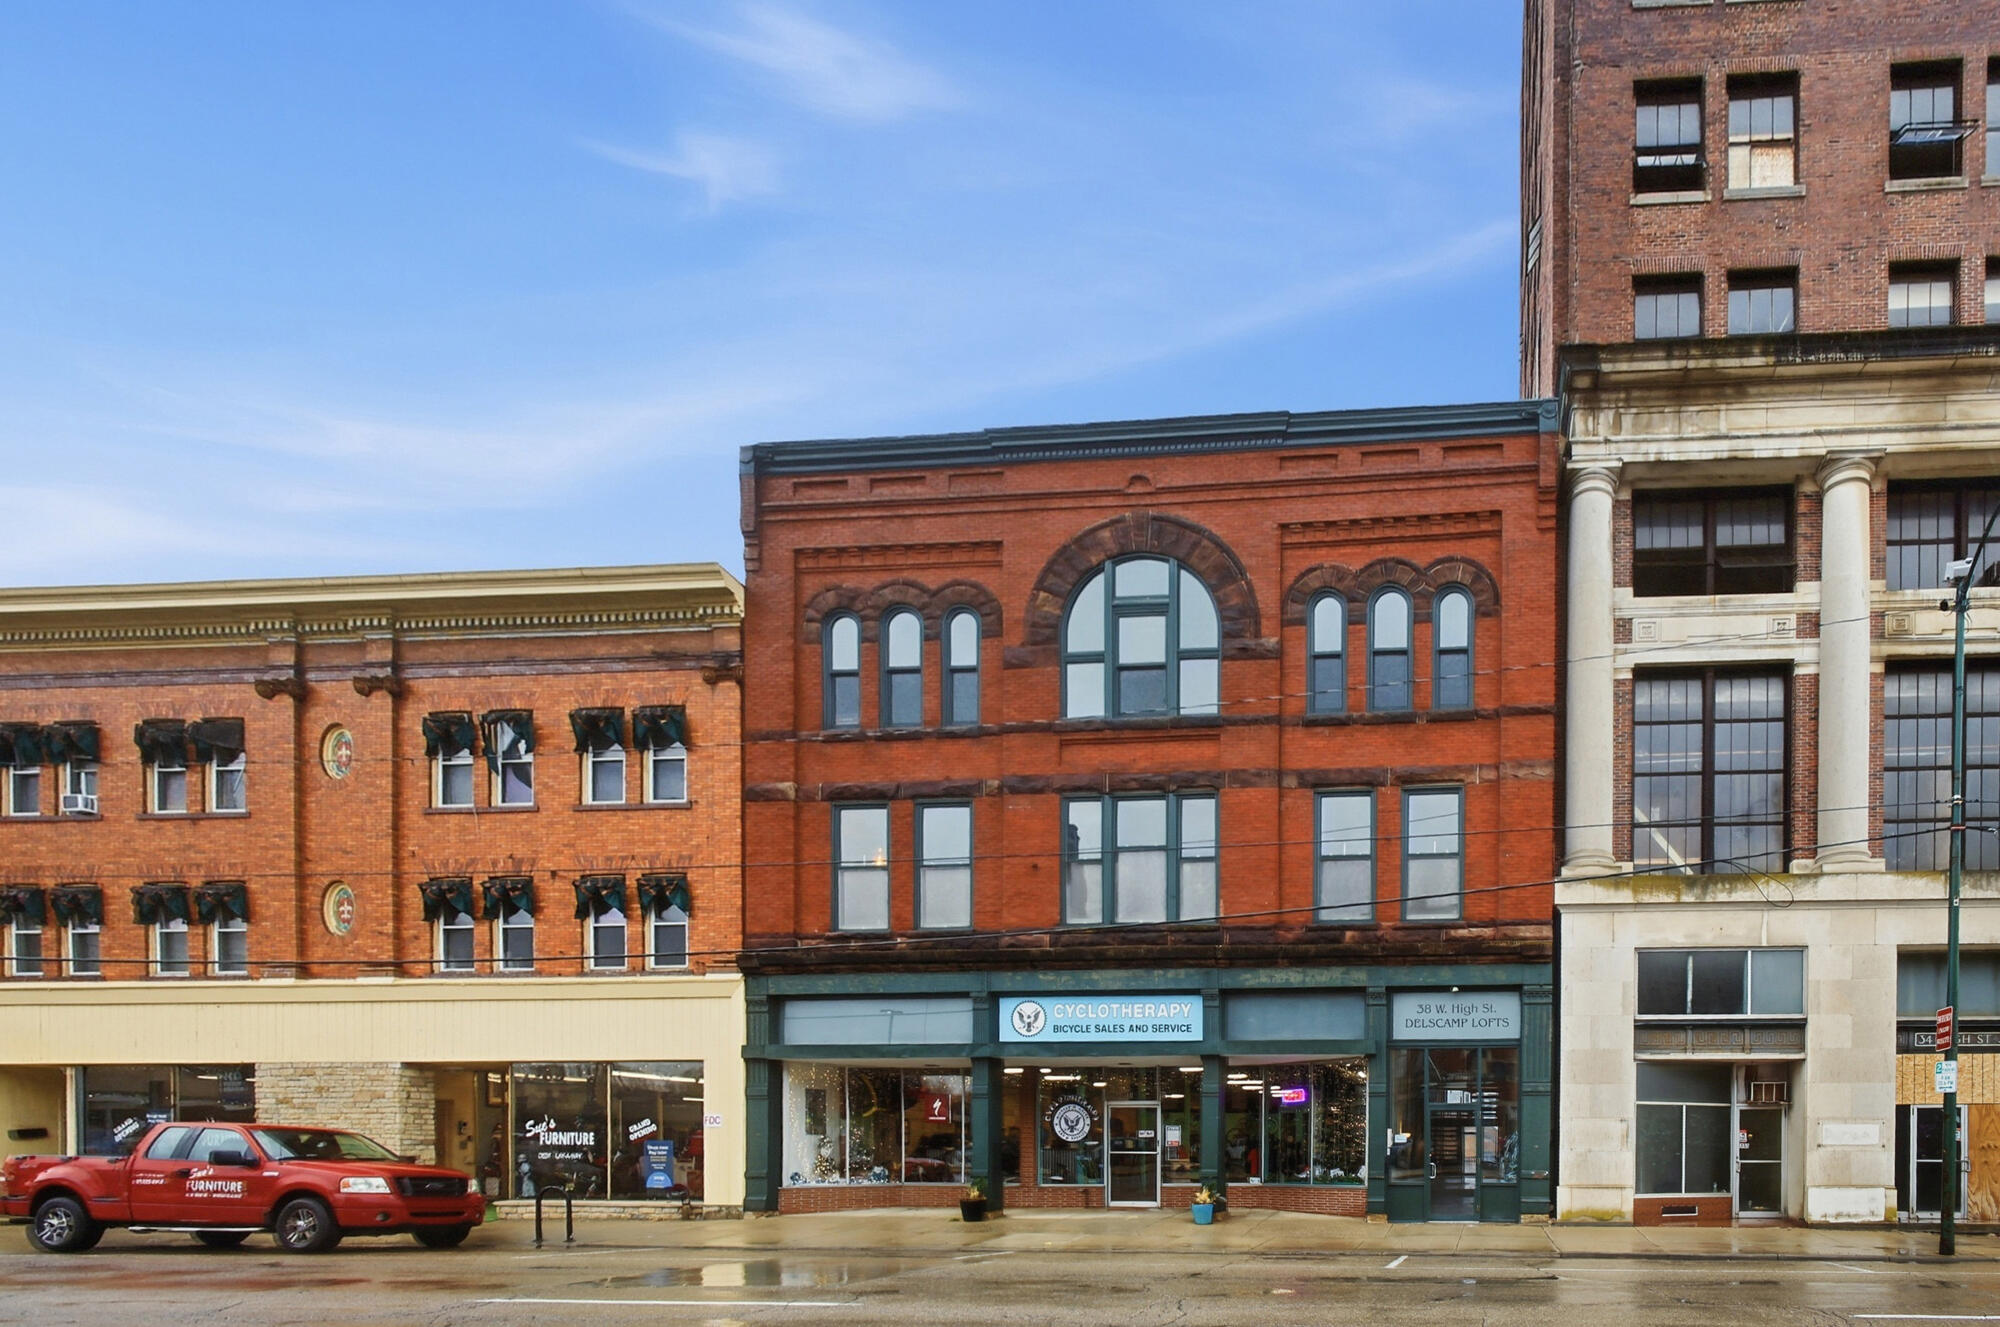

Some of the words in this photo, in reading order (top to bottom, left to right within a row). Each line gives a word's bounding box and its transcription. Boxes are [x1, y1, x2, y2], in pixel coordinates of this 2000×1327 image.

[1053, 1003, 1192, 1018] CYCLOTHERAPY
[1416, 1004, 1432, 1014] 38
[1435, 1003, 1447, 1014] W.
[1452, 1003, 1478, 1016] High
[1482, 1003, 1497, 1014] St.
[1053, 1024, 1091, 1033] BICYCLE
[1094, 1024, 1125, 1033] SALES
[1128, 1024, 1148, 1033] AND
[1151, 1023, 1192, 1033] SERVICE
[1405, 1018, 1468, 1028] DELSCAMP
[1471, 1017, 1510, 1028] LOFTS
[1918, 1035, 1933, 1044] 34
[1976, 1034, 1992, 1044] ST
[525, 1114, 556, 1137] Sue's
[704, 1115, 721, 1125] FDC
[540, 1131, 595, 1146] FURNITURE
[186, 1181, 243, 1193] FURNITURE
